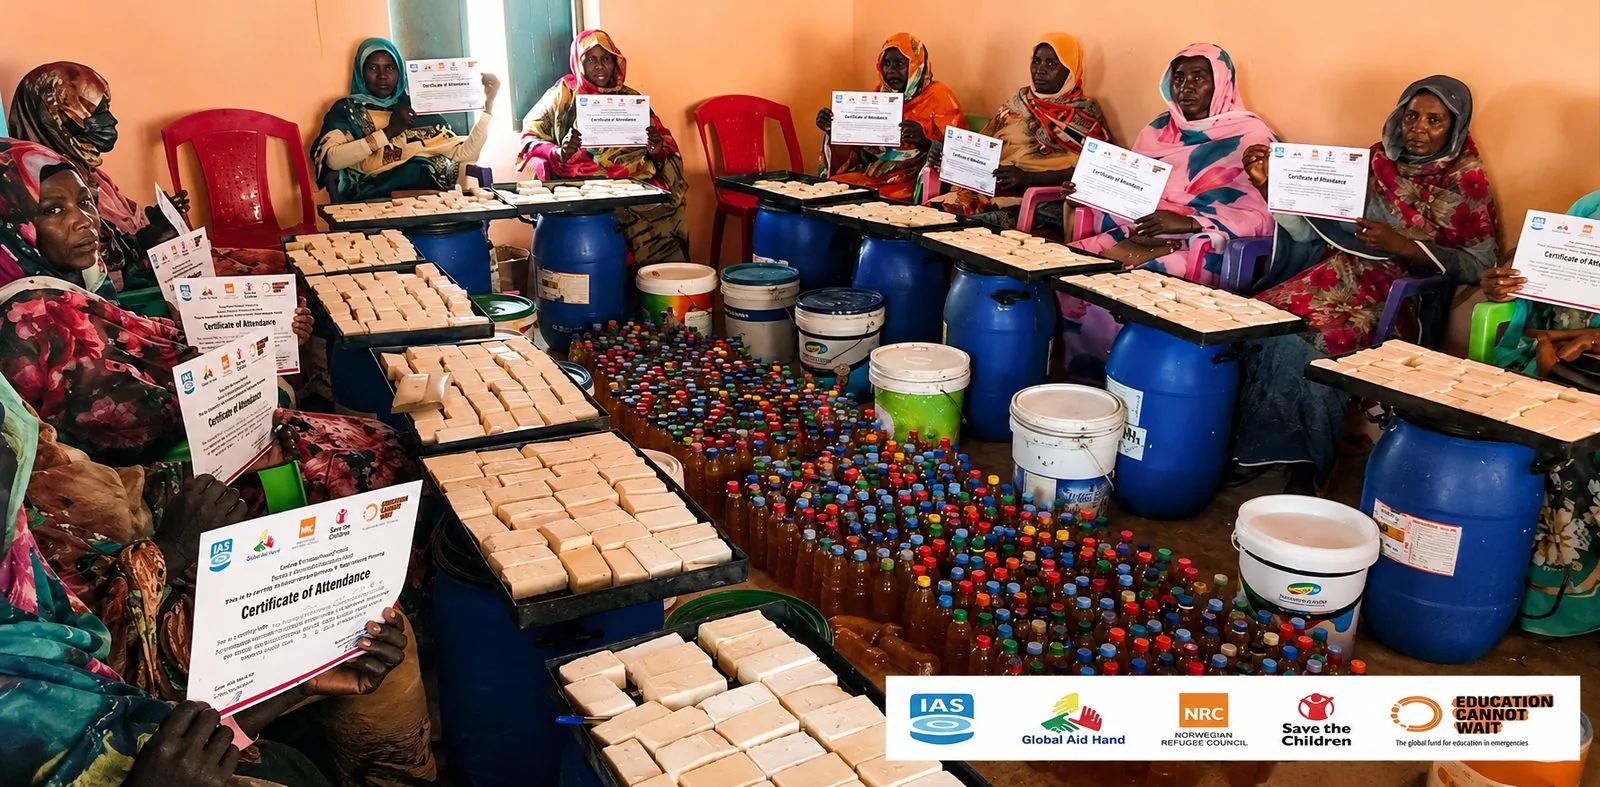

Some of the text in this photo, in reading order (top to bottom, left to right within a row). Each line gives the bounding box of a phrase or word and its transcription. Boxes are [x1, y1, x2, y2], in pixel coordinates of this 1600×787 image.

[1544, 250, 1578, 263] Certificate
[204, 320, 234, 331] Certificate
[243, 318, 276, 328] Attendance
[213, 540, 230, 554] IAS
[241, 591, 299, 620] Certificate
[301, 584, 314, 600] of
[315, 569, 371, 596] Attendance
